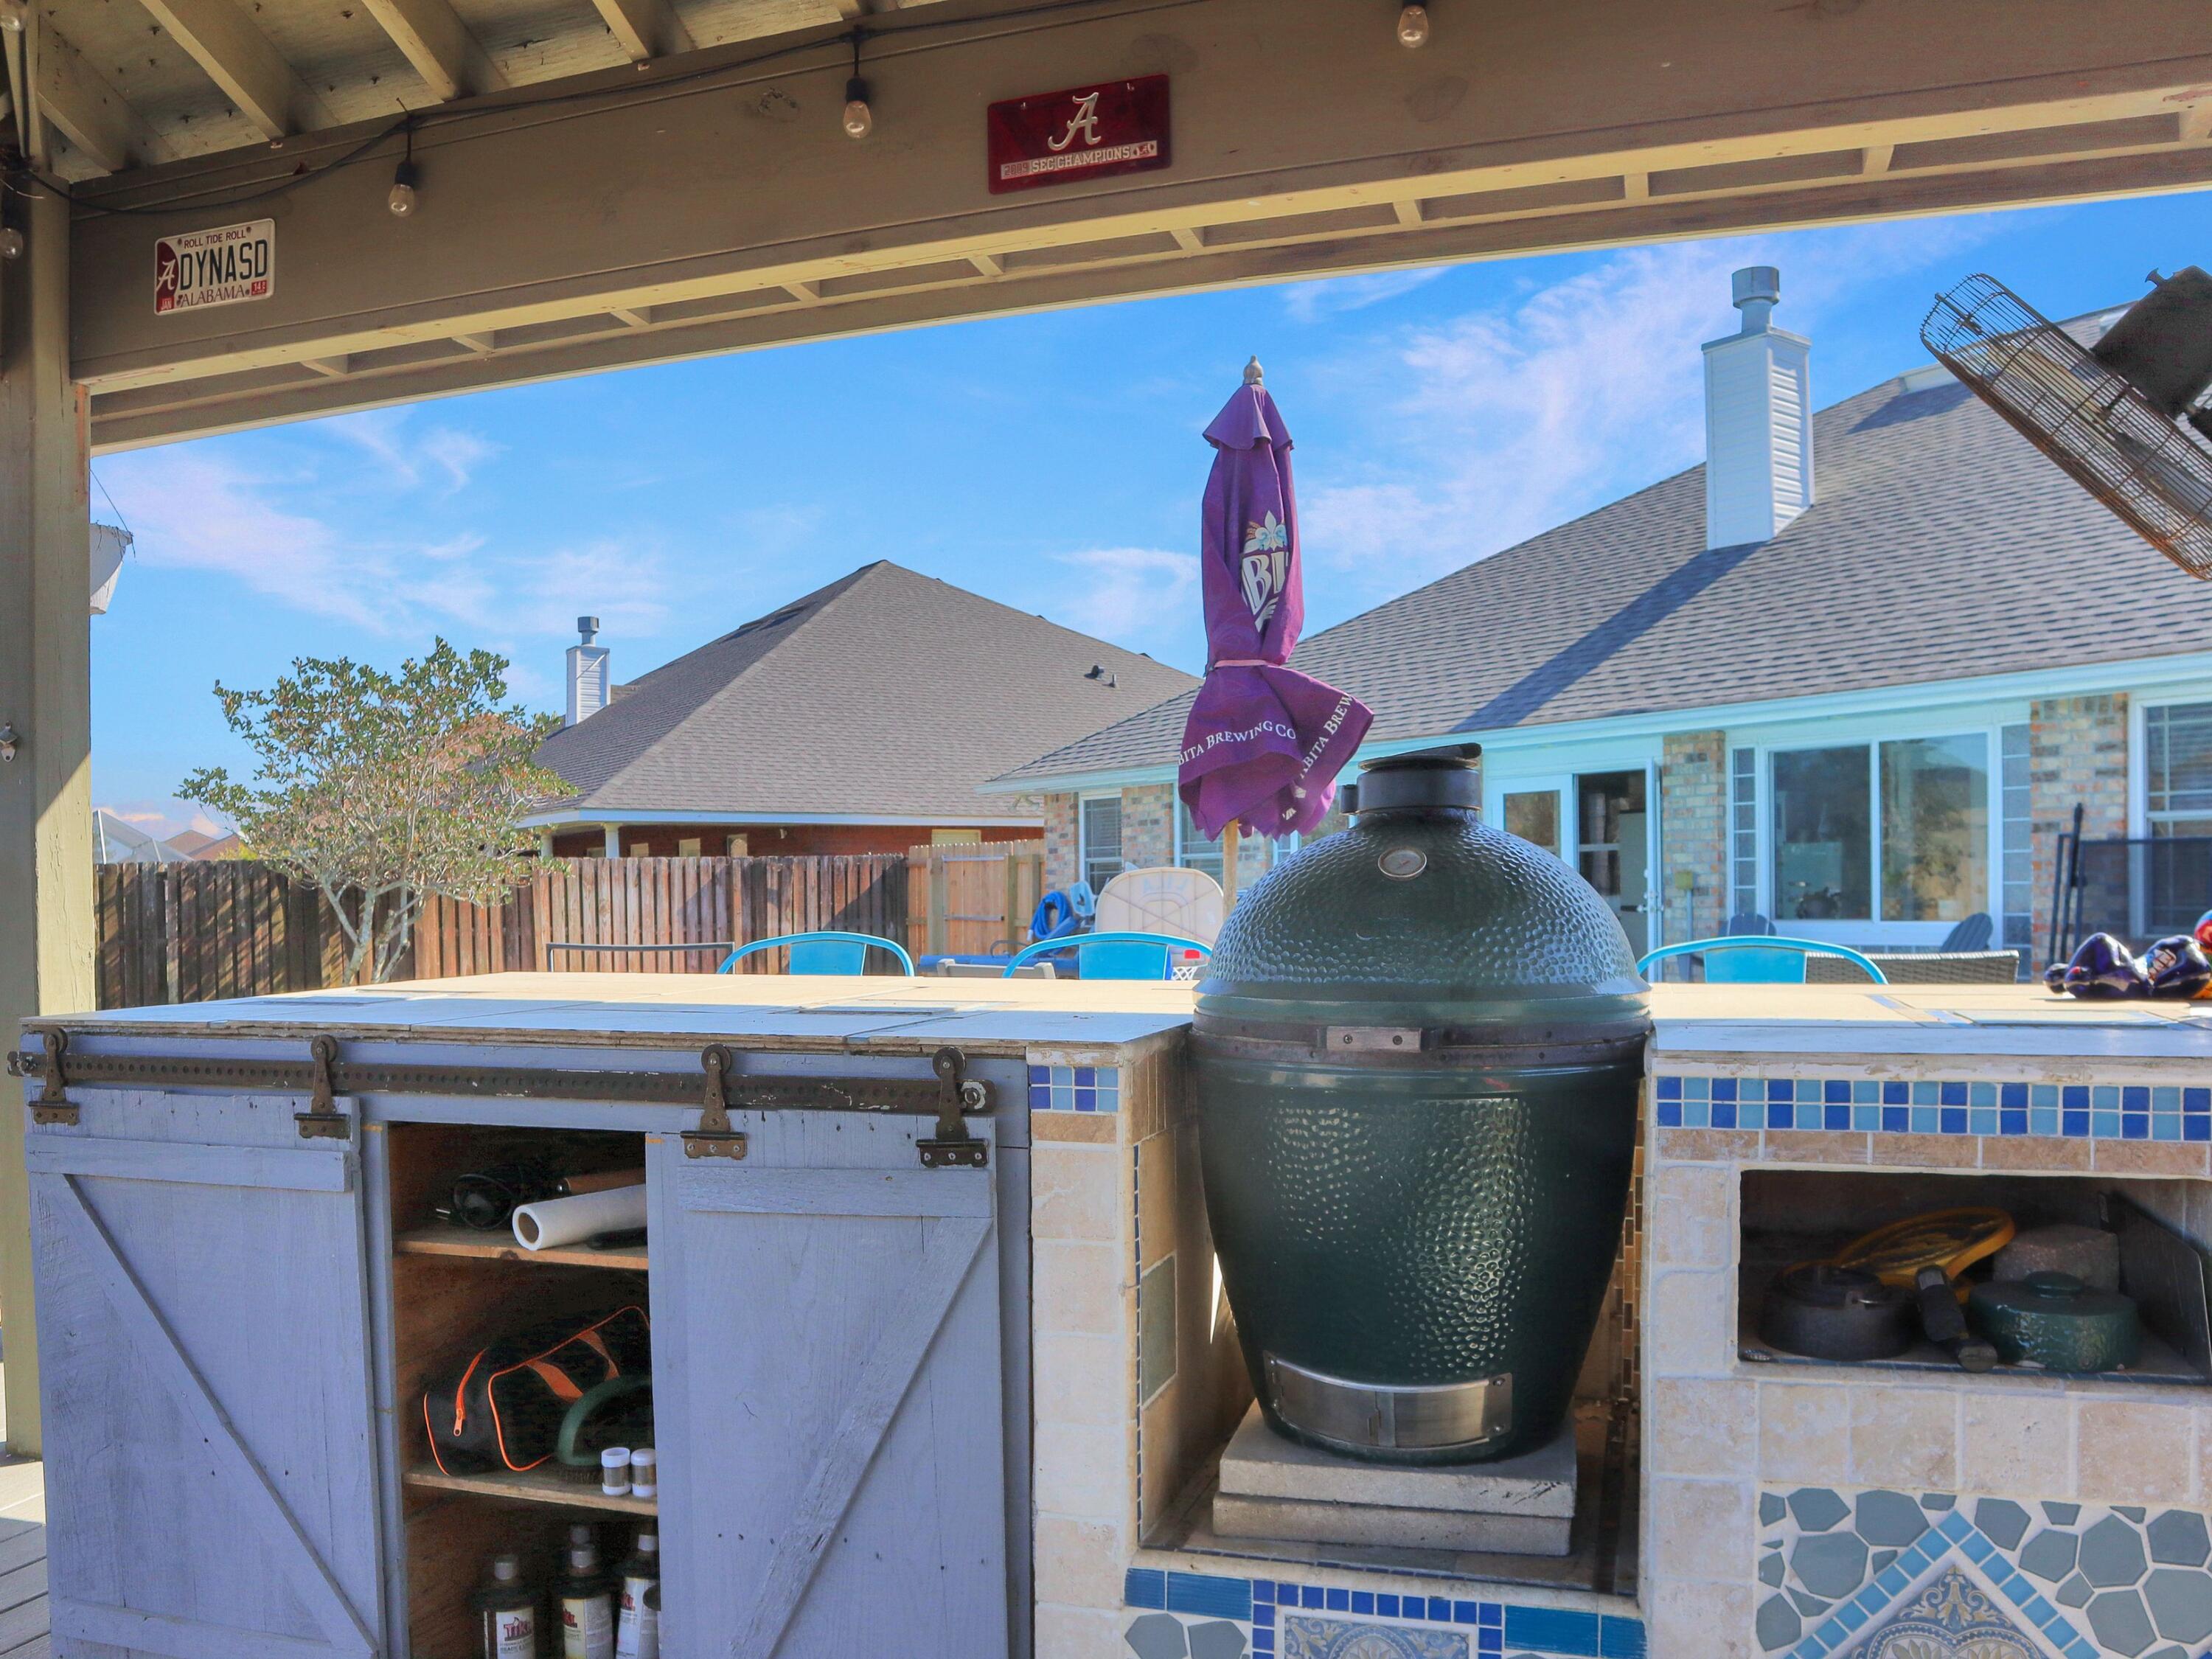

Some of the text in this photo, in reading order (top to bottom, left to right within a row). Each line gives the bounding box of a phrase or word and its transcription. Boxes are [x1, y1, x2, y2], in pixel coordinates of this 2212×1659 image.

[1048, 91, 1102, 151] A
[1032, 158, 1054, 173] SEC
[1057, 146, 1130, 168] CHAMPIONS
[184, 229, 246, 249] ROLL TIDE ROLL
[180, 239, 268, 291] DYNASD
[160, 299, 172, 310] JAN
[180, 285, 245, 307] ALABAMA
[1241, 551, 1289, 616] BI
[1206, 720, 1273, 750] BREWING
[1275, 723, 1296, 740] CO
